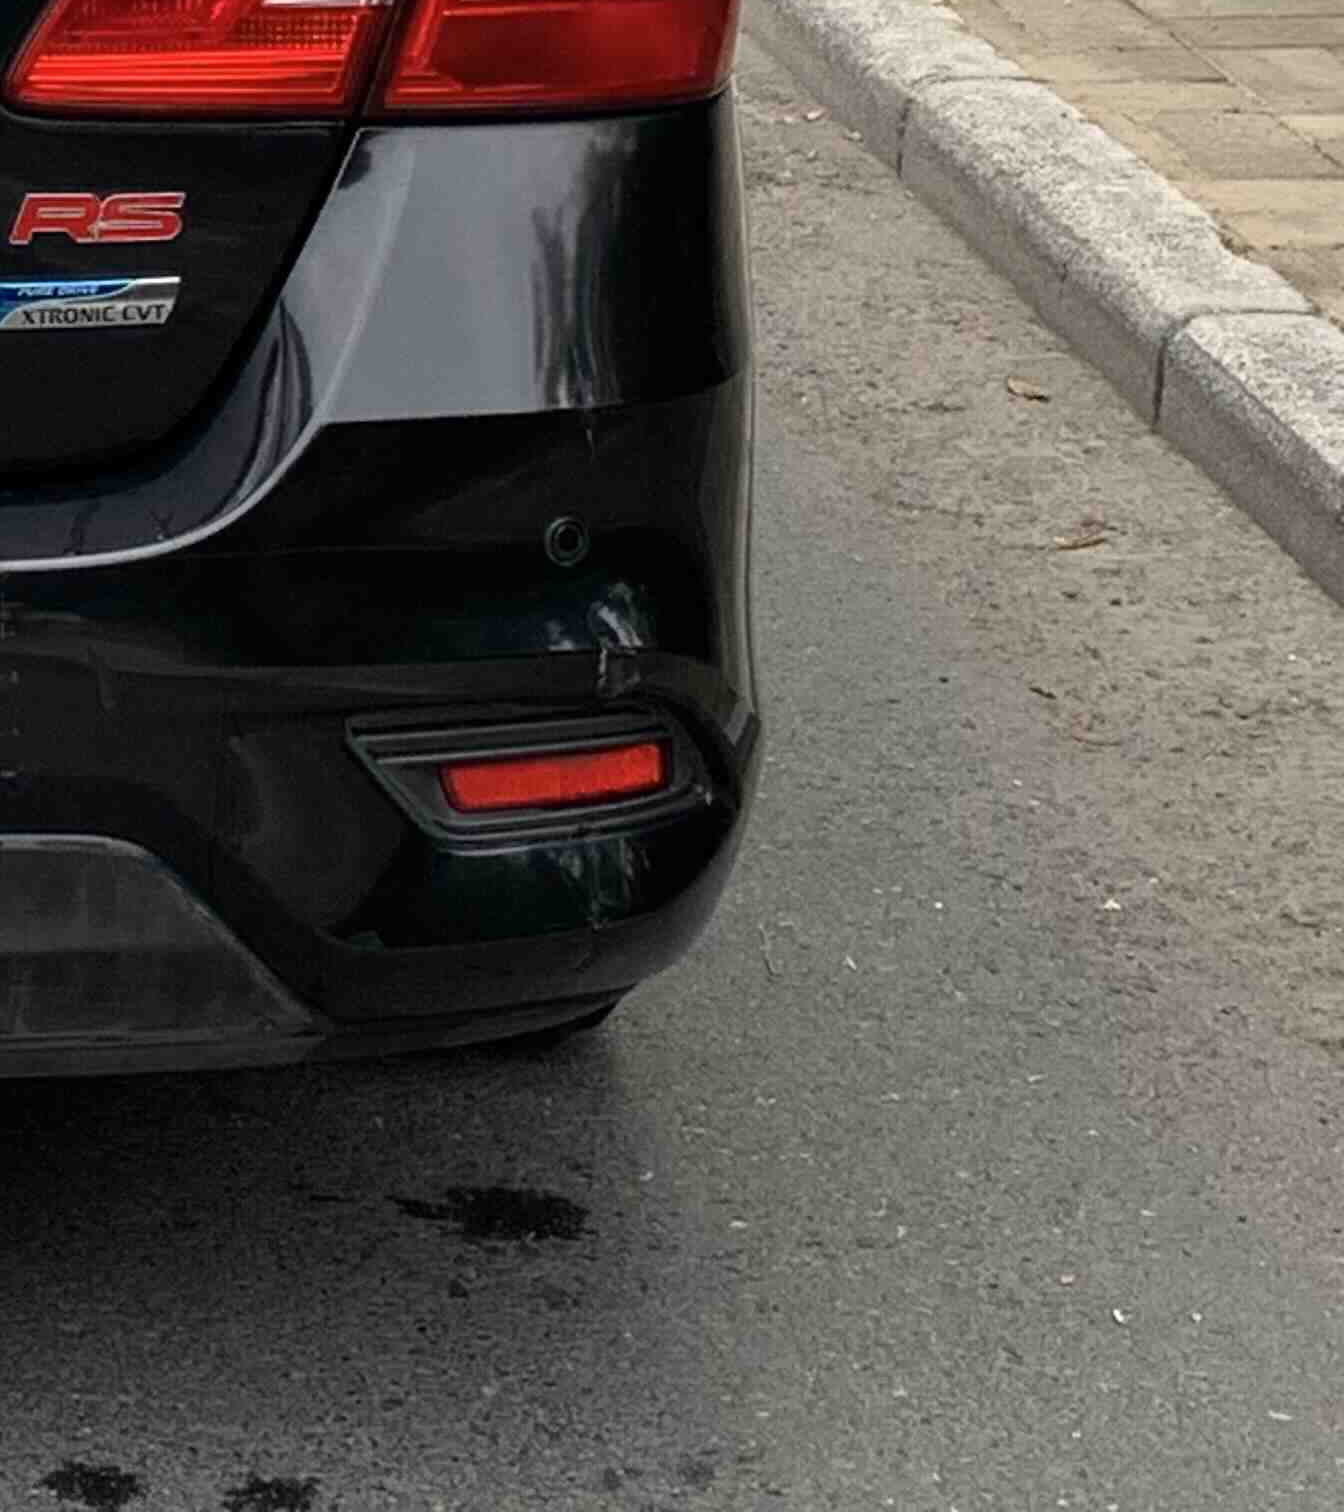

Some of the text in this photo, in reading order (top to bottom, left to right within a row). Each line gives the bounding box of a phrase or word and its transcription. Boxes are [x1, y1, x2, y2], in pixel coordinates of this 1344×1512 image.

[8, 191, 186, 245] RS
[21, 304, 166, 326] XTRONIC CVT
